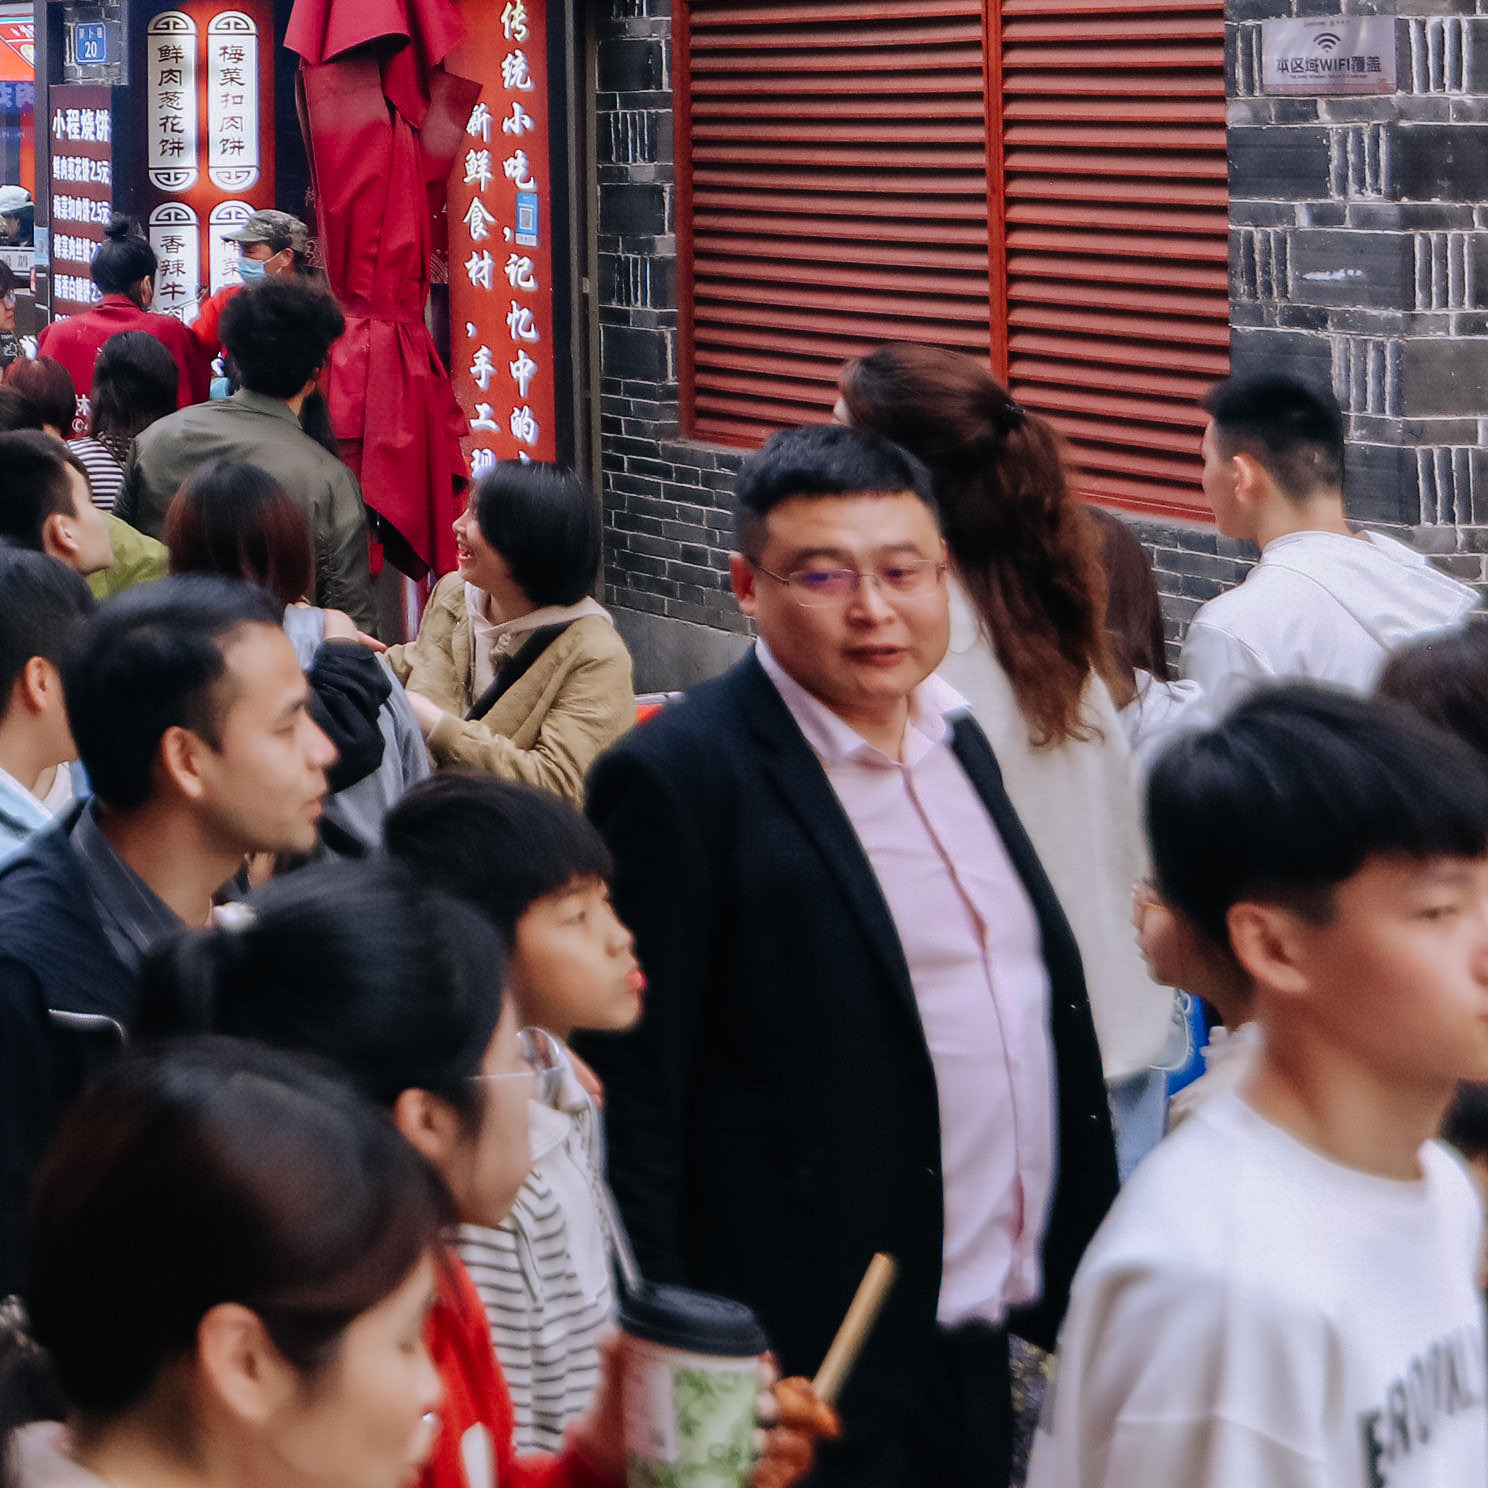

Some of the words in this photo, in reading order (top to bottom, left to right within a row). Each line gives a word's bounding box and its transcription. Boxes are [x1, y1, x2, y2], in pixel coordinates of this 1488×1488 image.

[84, 41, 97, 58] 20
[1276, 55, 1382, 73] 本区域WIFI覆盖
[157, 44, 185, 158] 鲜肉葱花饼
[218, 44, 246, 158] 梅菜扣肉饼
[52, 108, 111, 142] 小程烧饼
